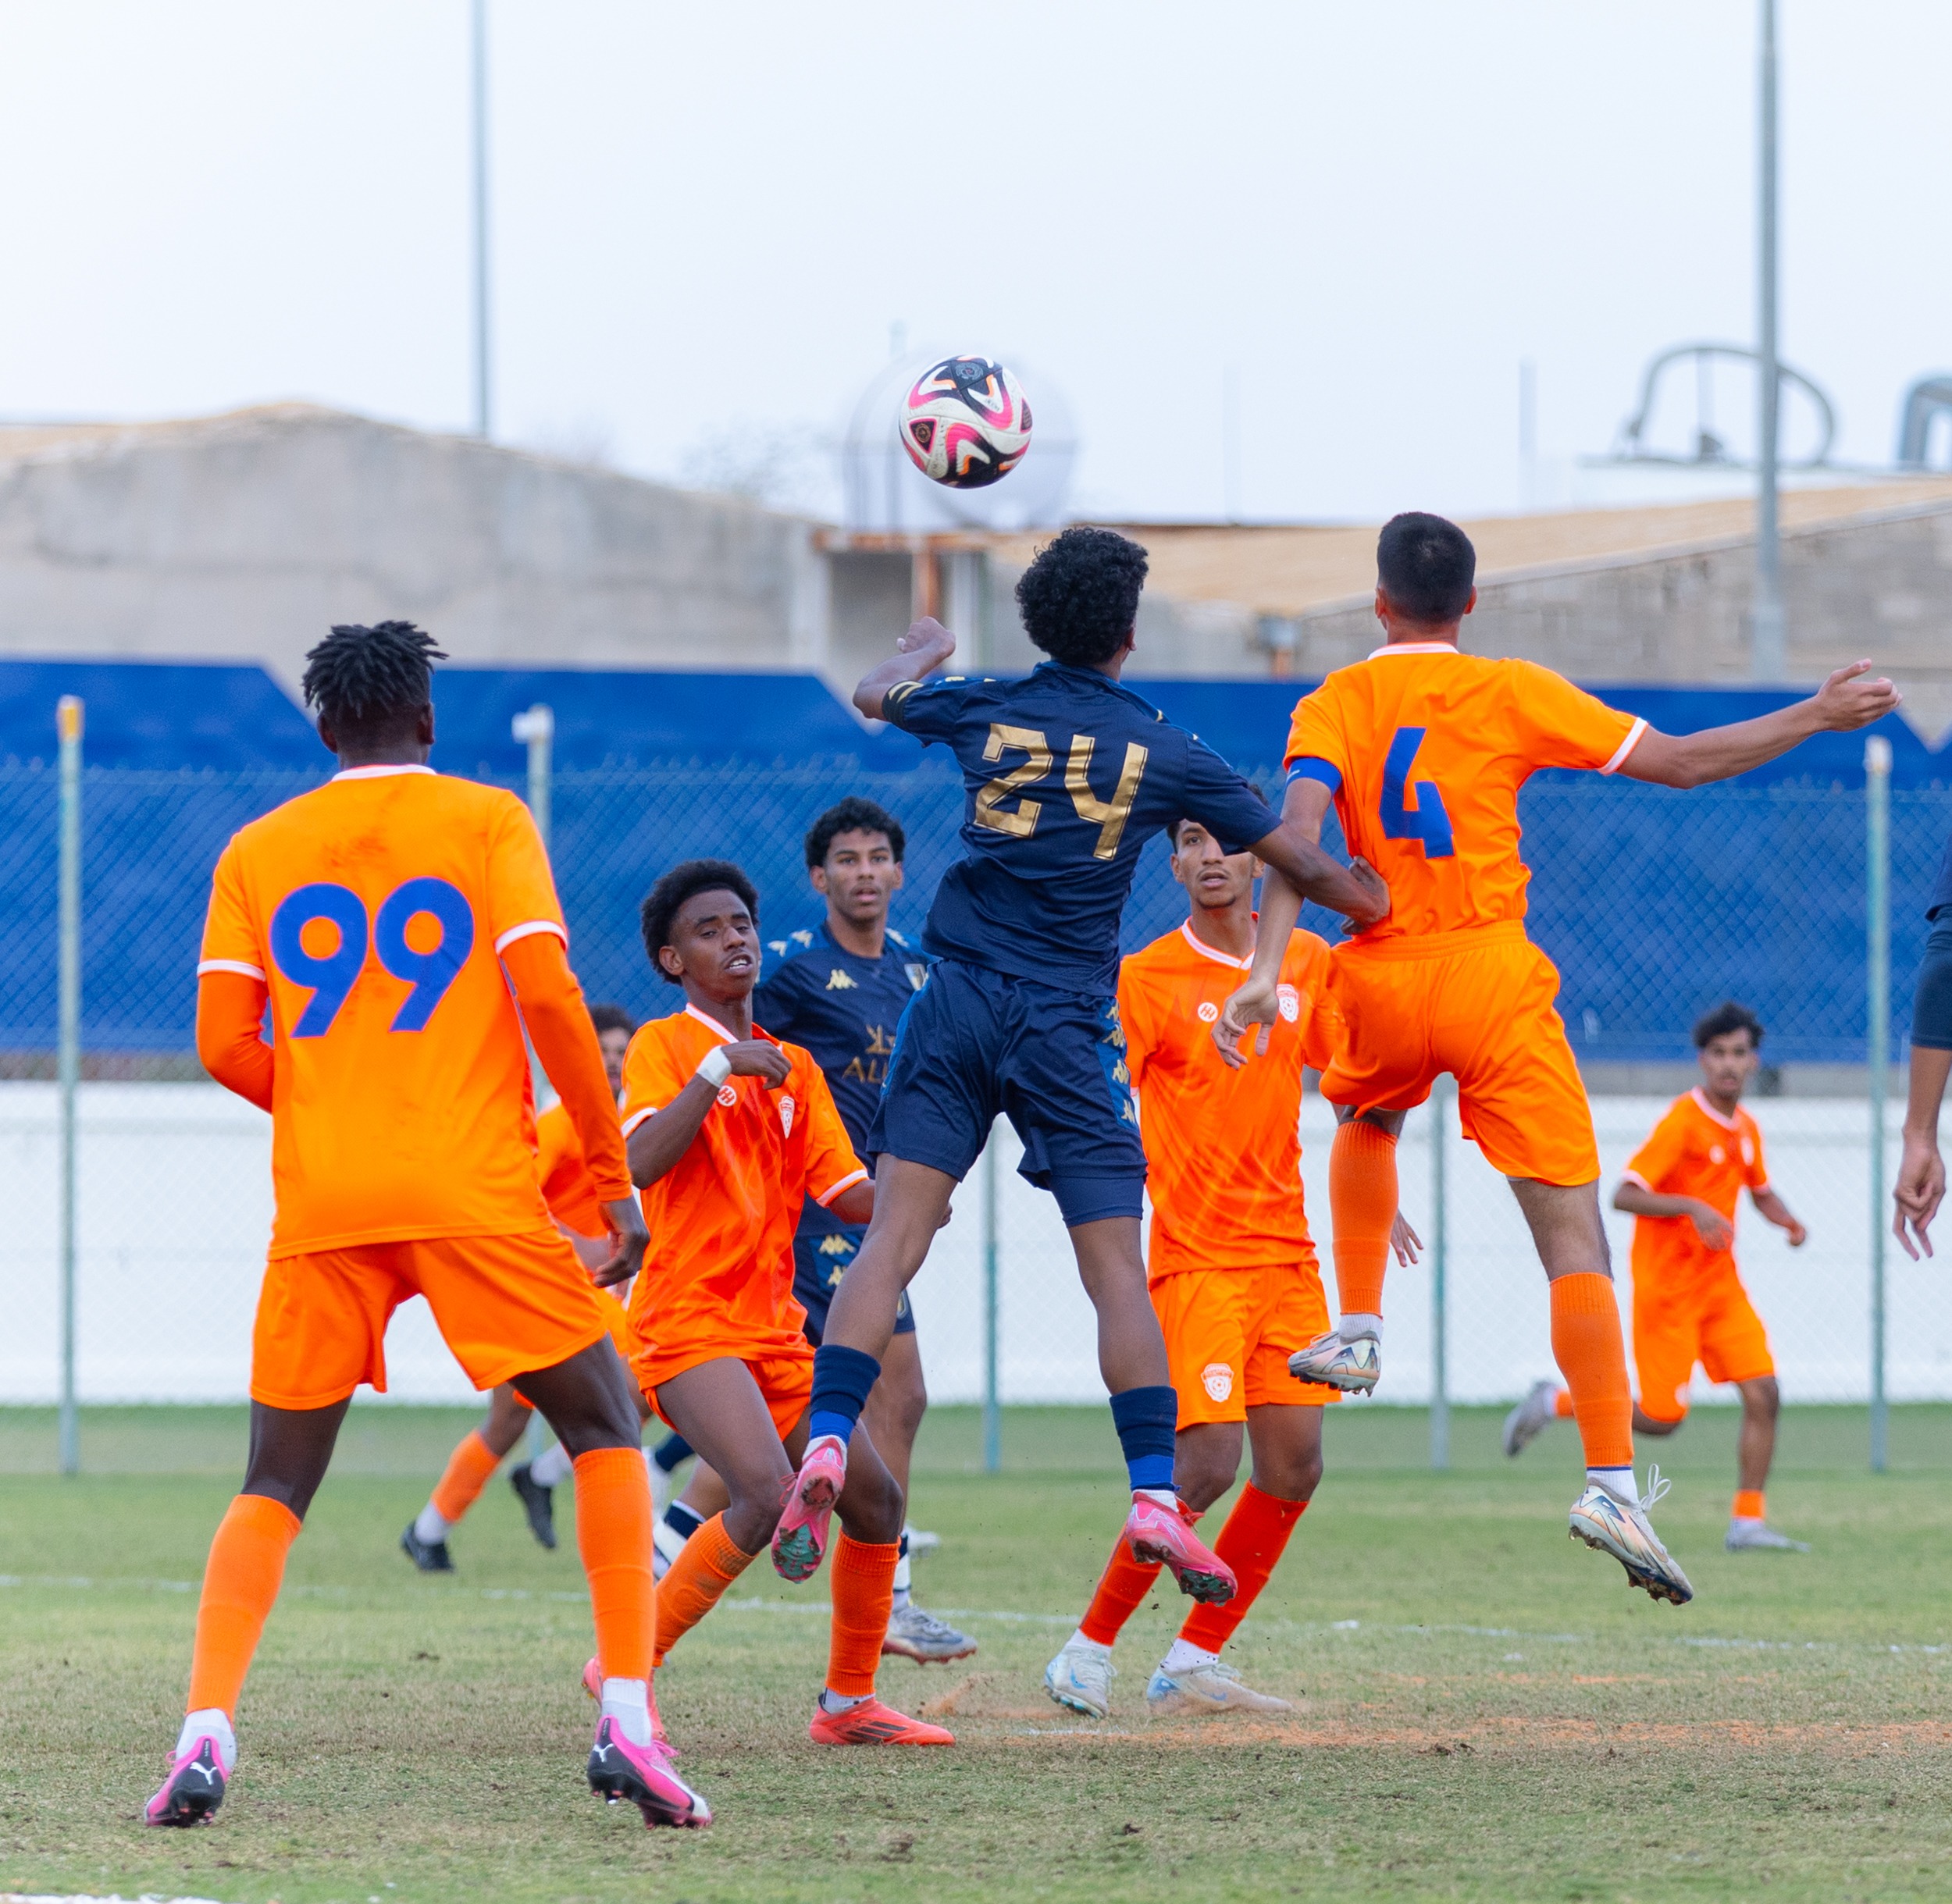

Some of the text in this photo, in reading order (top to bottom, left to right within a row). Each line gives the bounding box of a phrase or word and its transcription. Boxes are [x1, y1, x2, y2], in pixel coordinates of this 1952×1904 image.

[974, 722, 1149, 861] 24
[1378, 726, 1455, 859] 4
[269, 876, 475, 1039] 99
